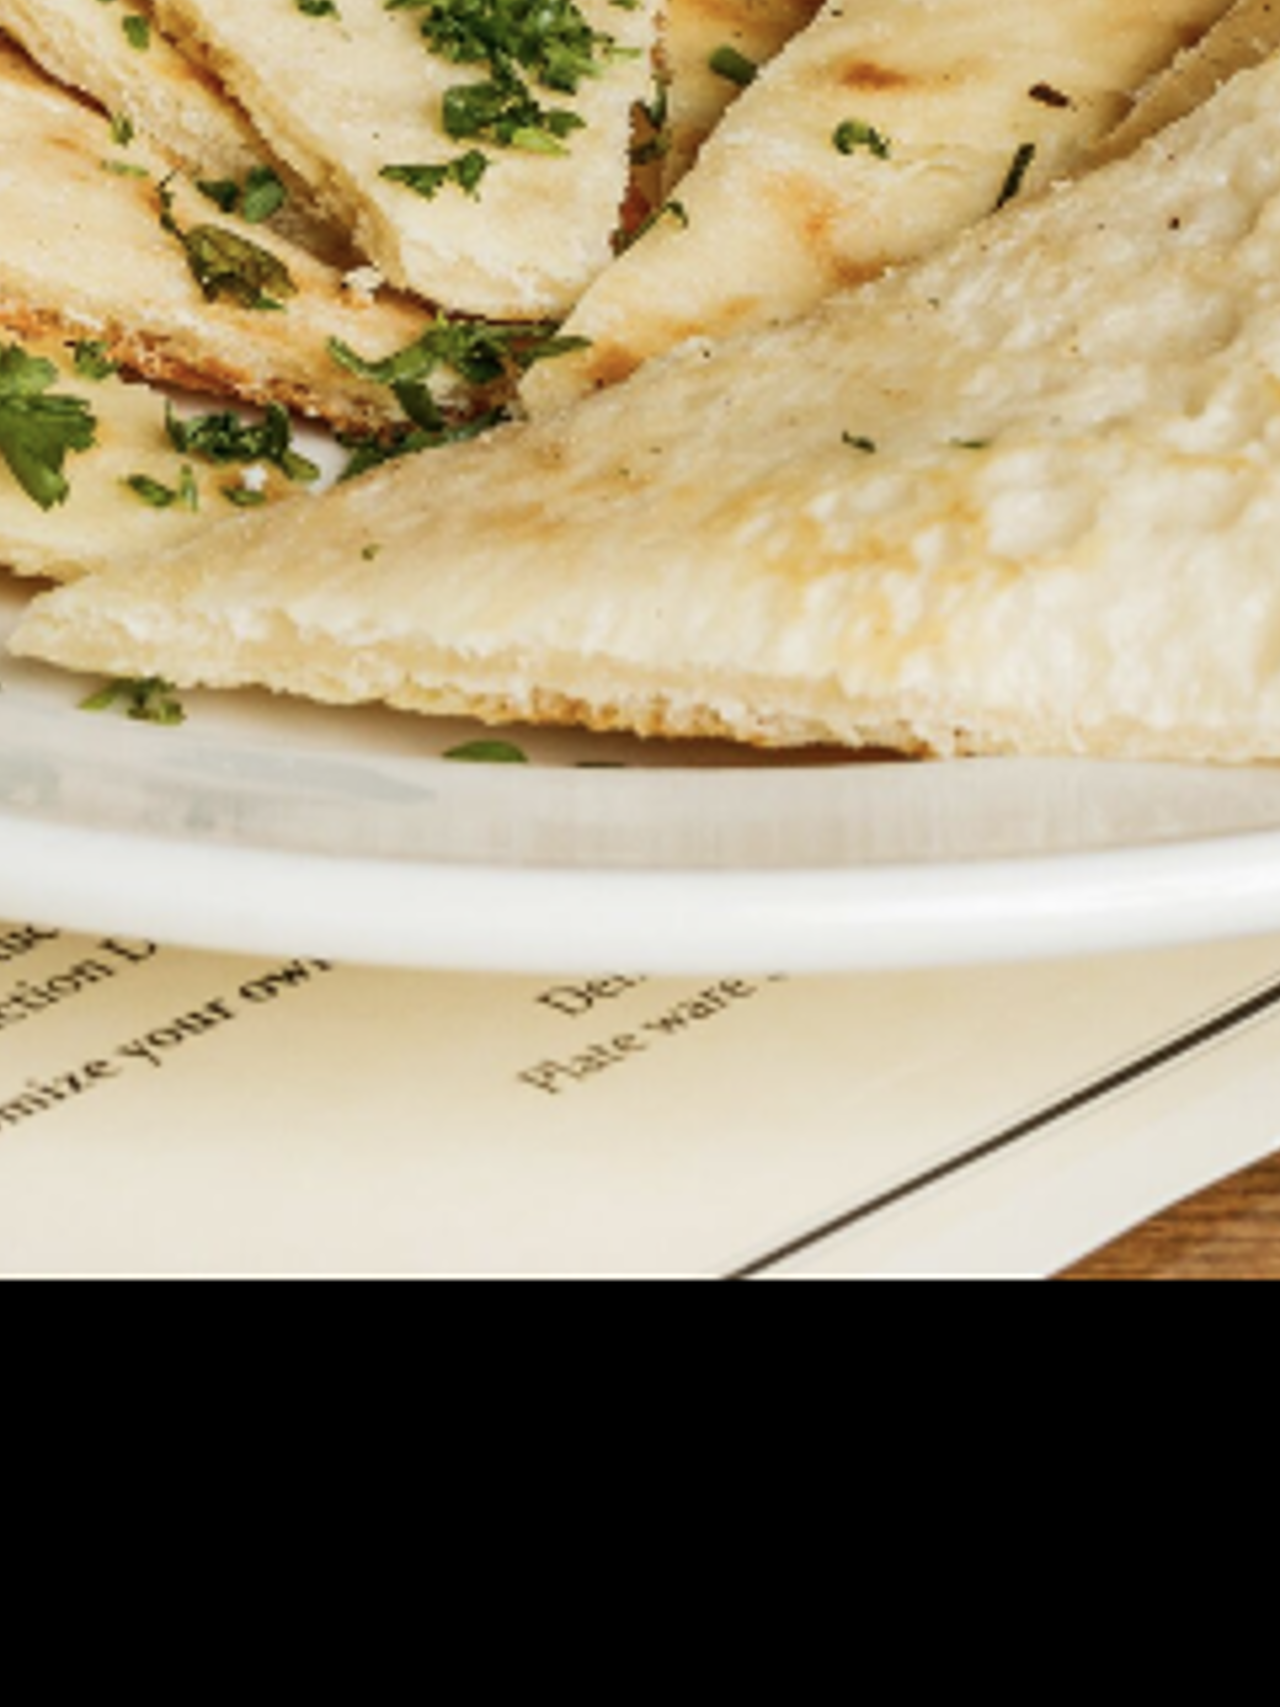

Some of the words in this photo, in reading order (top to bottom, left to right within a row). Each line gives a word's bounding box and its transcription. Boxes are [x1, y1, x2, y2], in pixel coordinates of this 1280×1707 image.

[115, 997, 239, 1068] your
[517, 1033, 649, 1095] Plate
[641, 979, 759, 1034] ware
